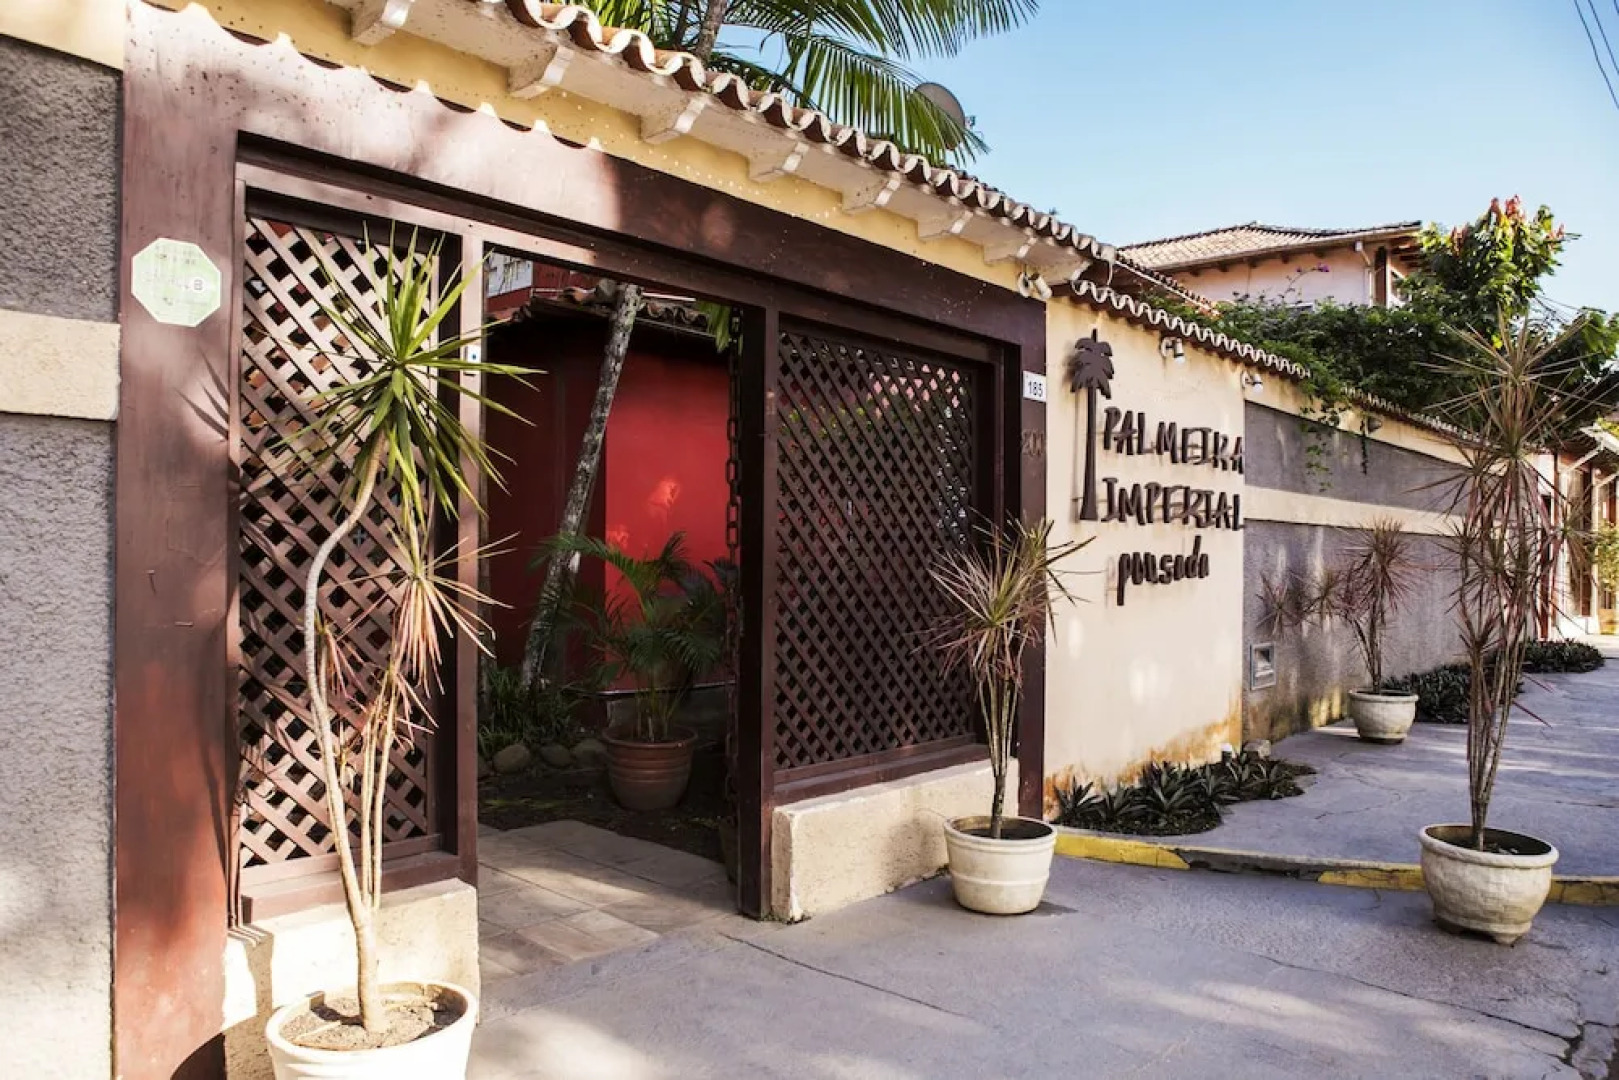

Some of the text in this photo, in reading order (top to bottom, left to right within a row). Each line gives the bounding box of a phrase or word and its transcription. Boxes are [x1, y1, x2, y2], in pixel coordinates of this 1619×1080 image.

[1027, 381, 1043, 398] 185
[1103, 406, 1244, 474] PALMEIRA
[1101, 477, 1244, 531] IMPERIAL
[1116, 535, 1209, 606] pousada
